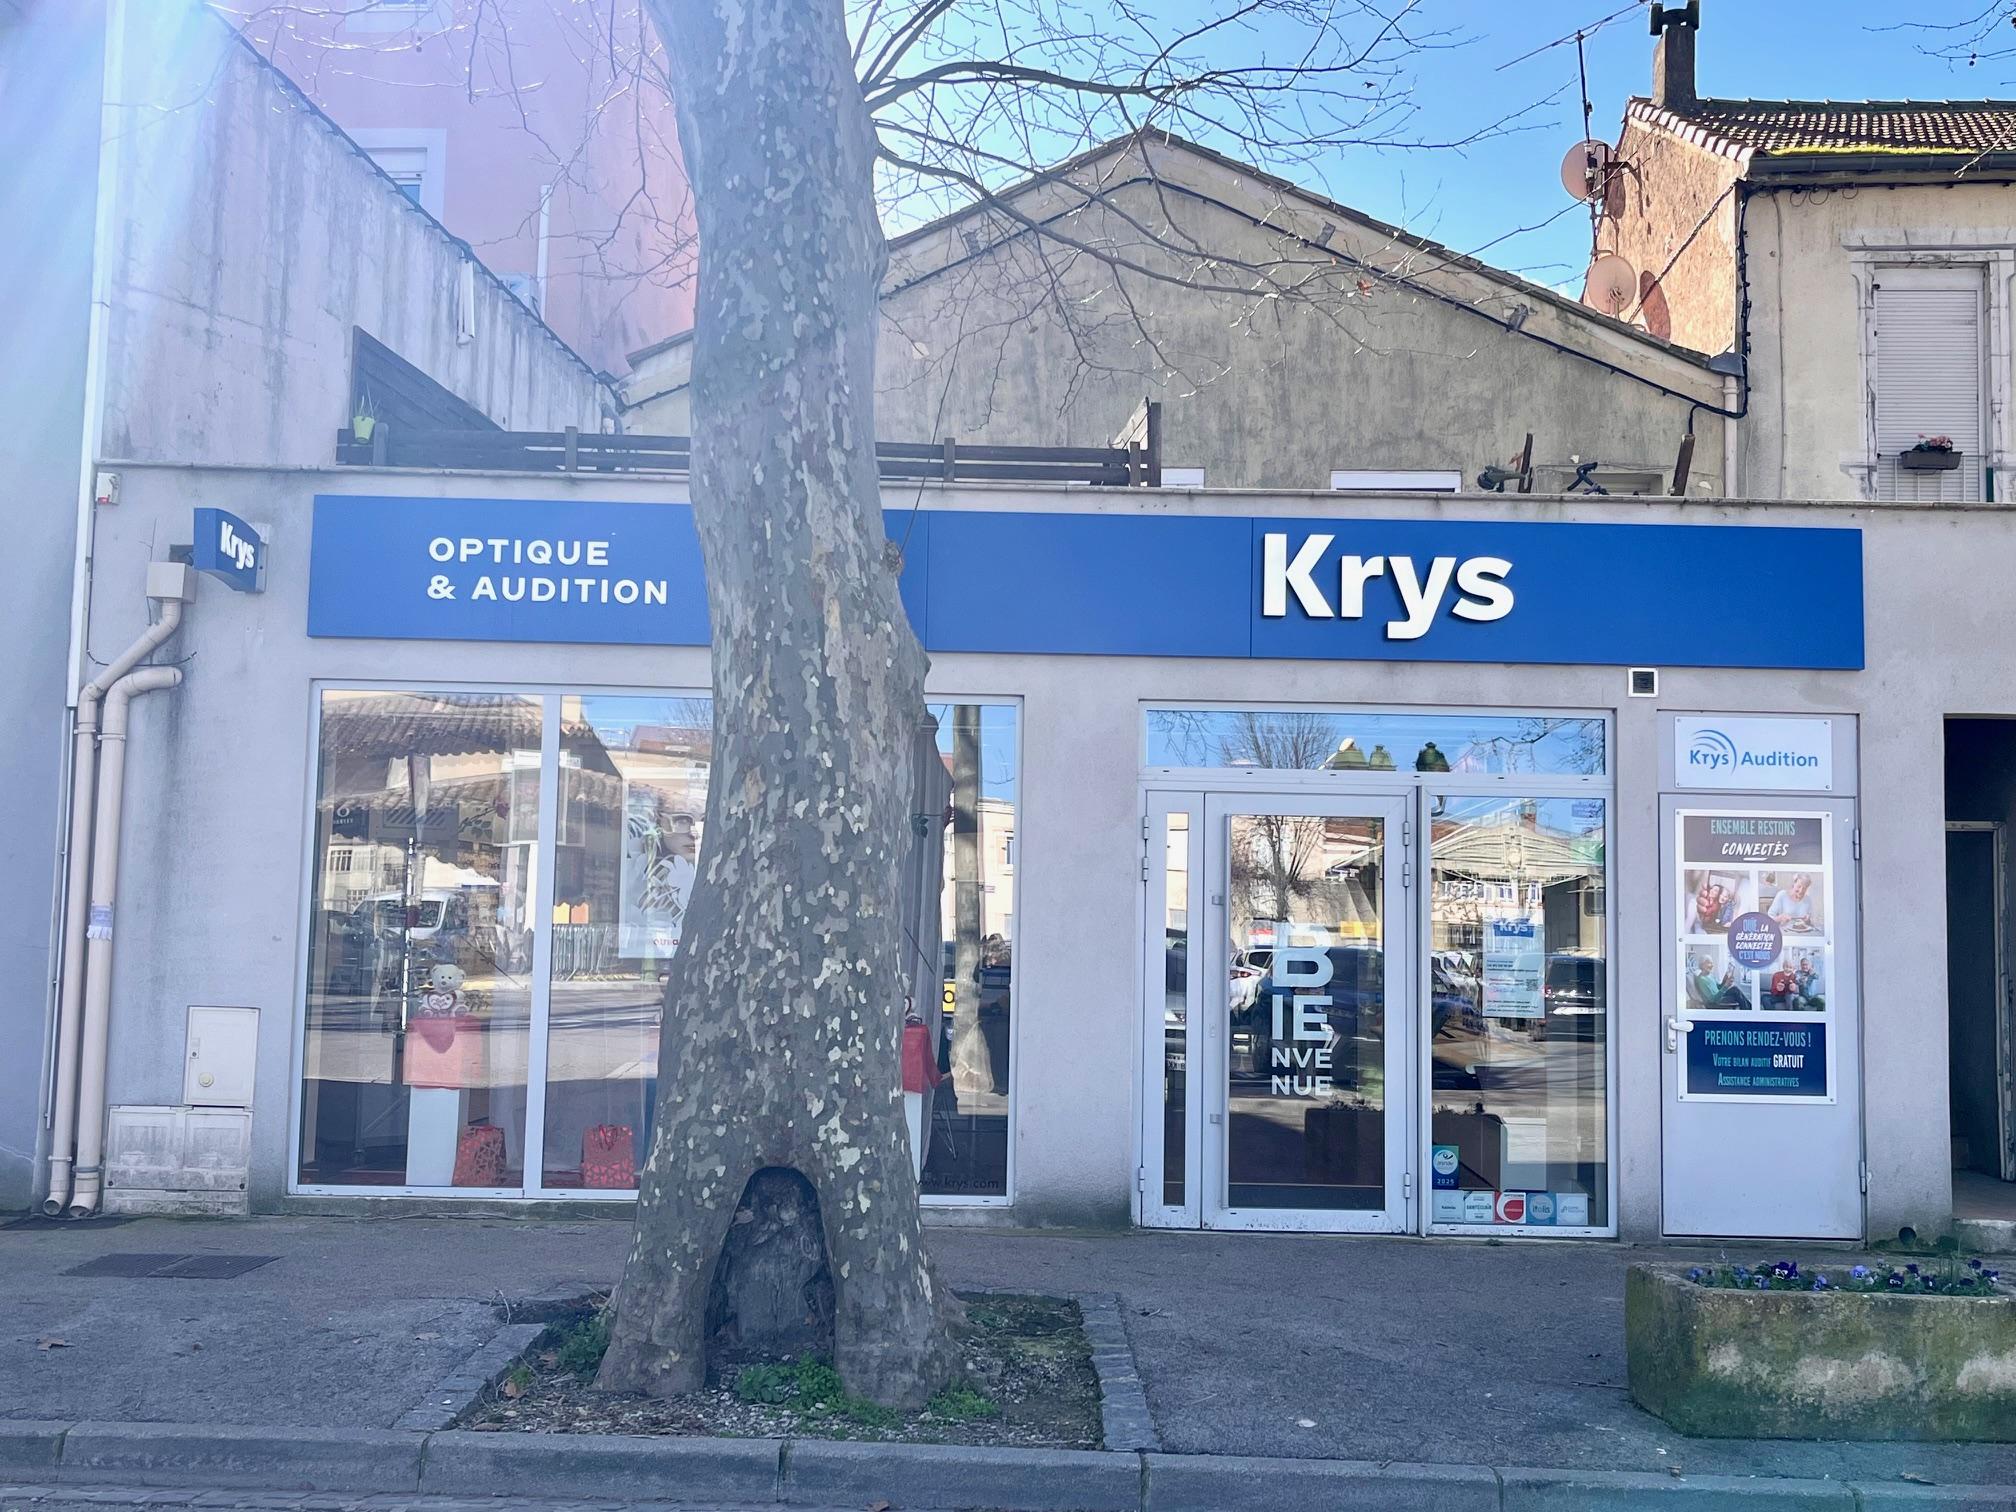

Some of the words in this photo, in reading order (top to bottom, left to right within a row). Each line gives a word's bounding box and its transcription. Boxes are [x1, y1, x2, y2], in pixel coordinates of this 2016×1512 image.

[220, 520, 255, 570] Krys
[428, 537, 610, 566] OPTIQUE
[426, 574, 457, 600] &
[471, 576, 668, 605] AUDITION
[1262, 532, 1516, 640] Krys
[1689, 749, 1730, 769] Krys
[1741, 751, 1818, 768] Audition
[1710, 819, 1756, 835] ENSEMBLE
[1757, 820, 1796, 836] RESTONS
[1721, 841, 1790, 857] CONNECTÉS
[1499, 921, 1529, 934] Krys
[1760, 924, 1769, 932] LA
[1704, 1030, 1745, 1046] PRENONS
[1746, 1031, 1807, 1047] RENDEZ-VOUS
[1271, 1047, 1333, 1069] NVE
[1773, 1054, 1804, 1069] GRATUIT
[1271, 1075, 1333, 1096] NUE
